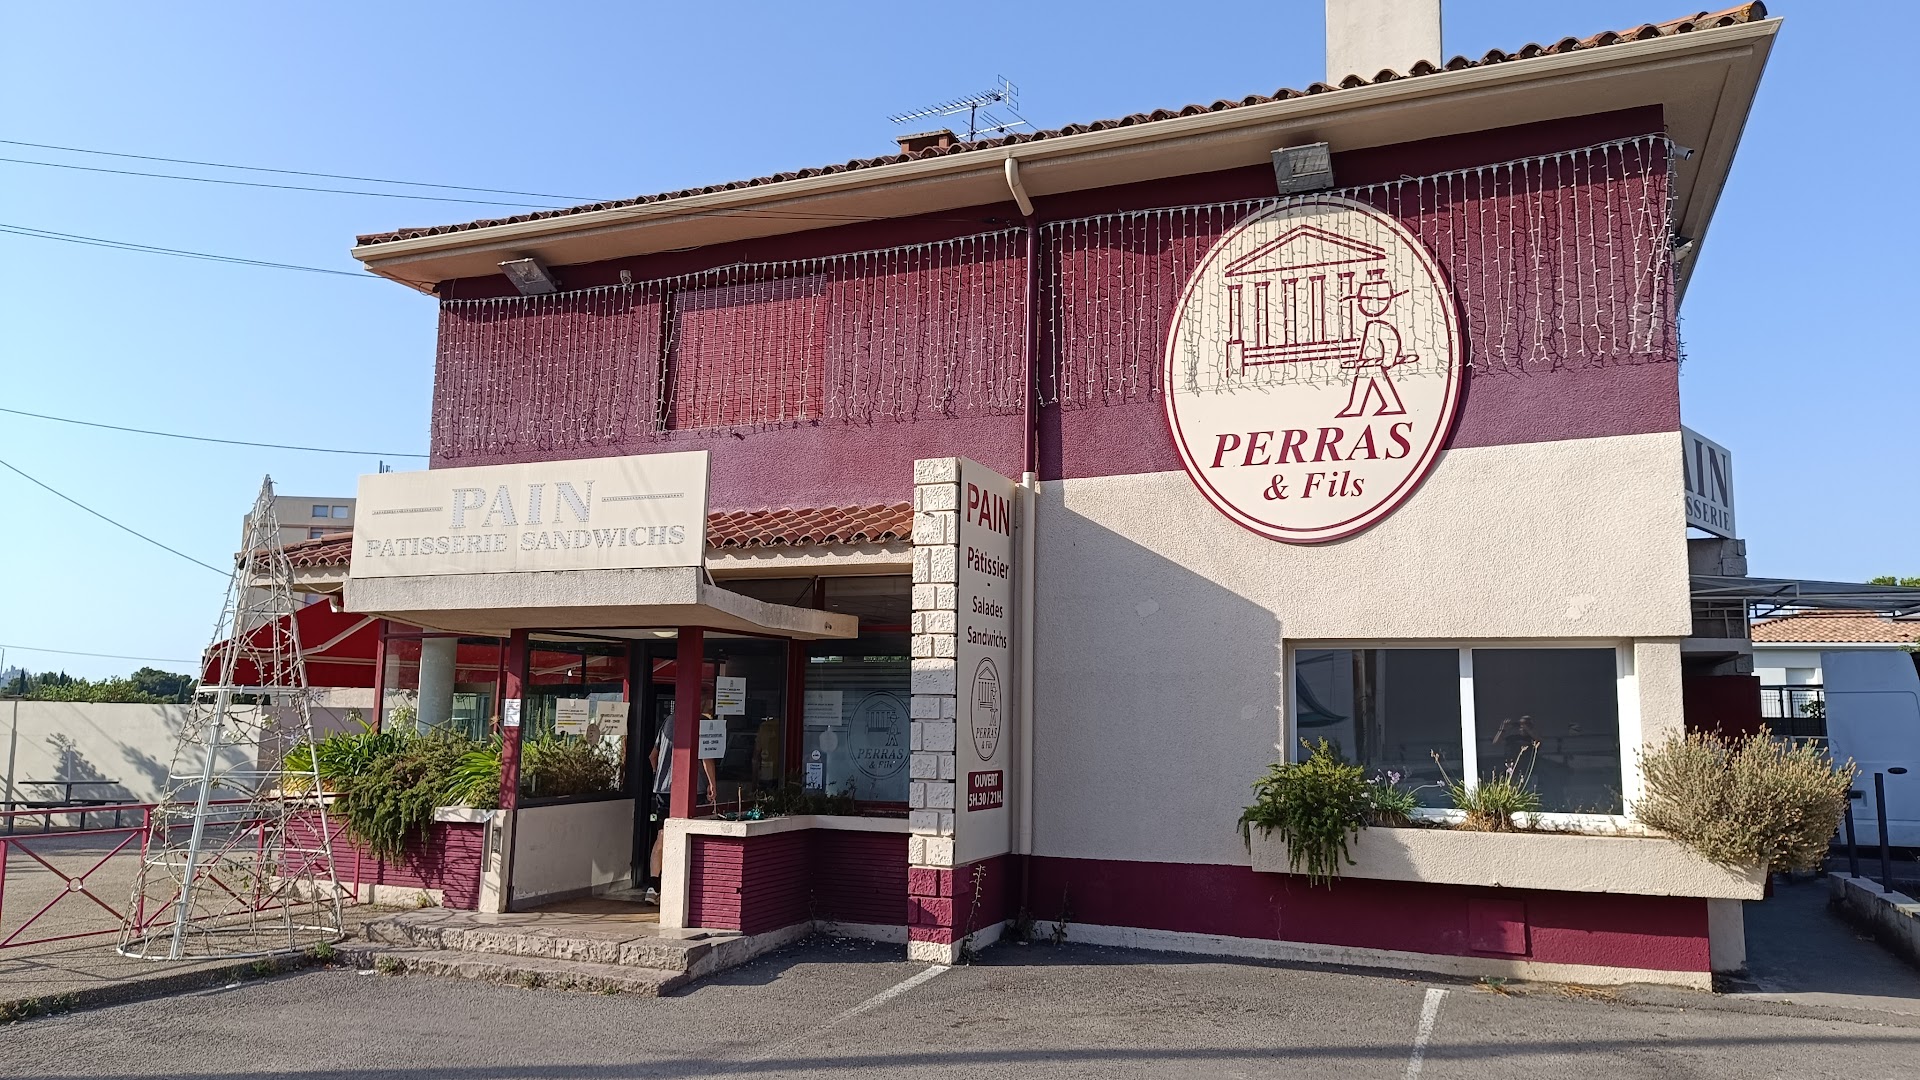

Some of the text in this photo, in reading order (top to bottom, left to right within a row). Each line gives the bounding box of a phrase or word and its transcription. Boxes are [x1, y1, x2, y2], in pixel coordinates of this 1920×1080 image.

[1209, 421, 1414, 469] PERRAS
[1263, 470, 1365, 501] & Fils
[448, 479, 596, 530] PAIN
[966, 482, 1010, 537] PAIN
[365, 524, 686, 558] PATISSERIE SANDWICHS
[967, 546, 1010, 580] Pâtissier
[972, 595, 1003, 619] Salades
[967, 625, 1007, 649] Sandwichs
[976, 727, 998, 739] PERRAS
[857, 748, 905, 760] PERRAS
[974, 773, 999, 788] OUVERT
